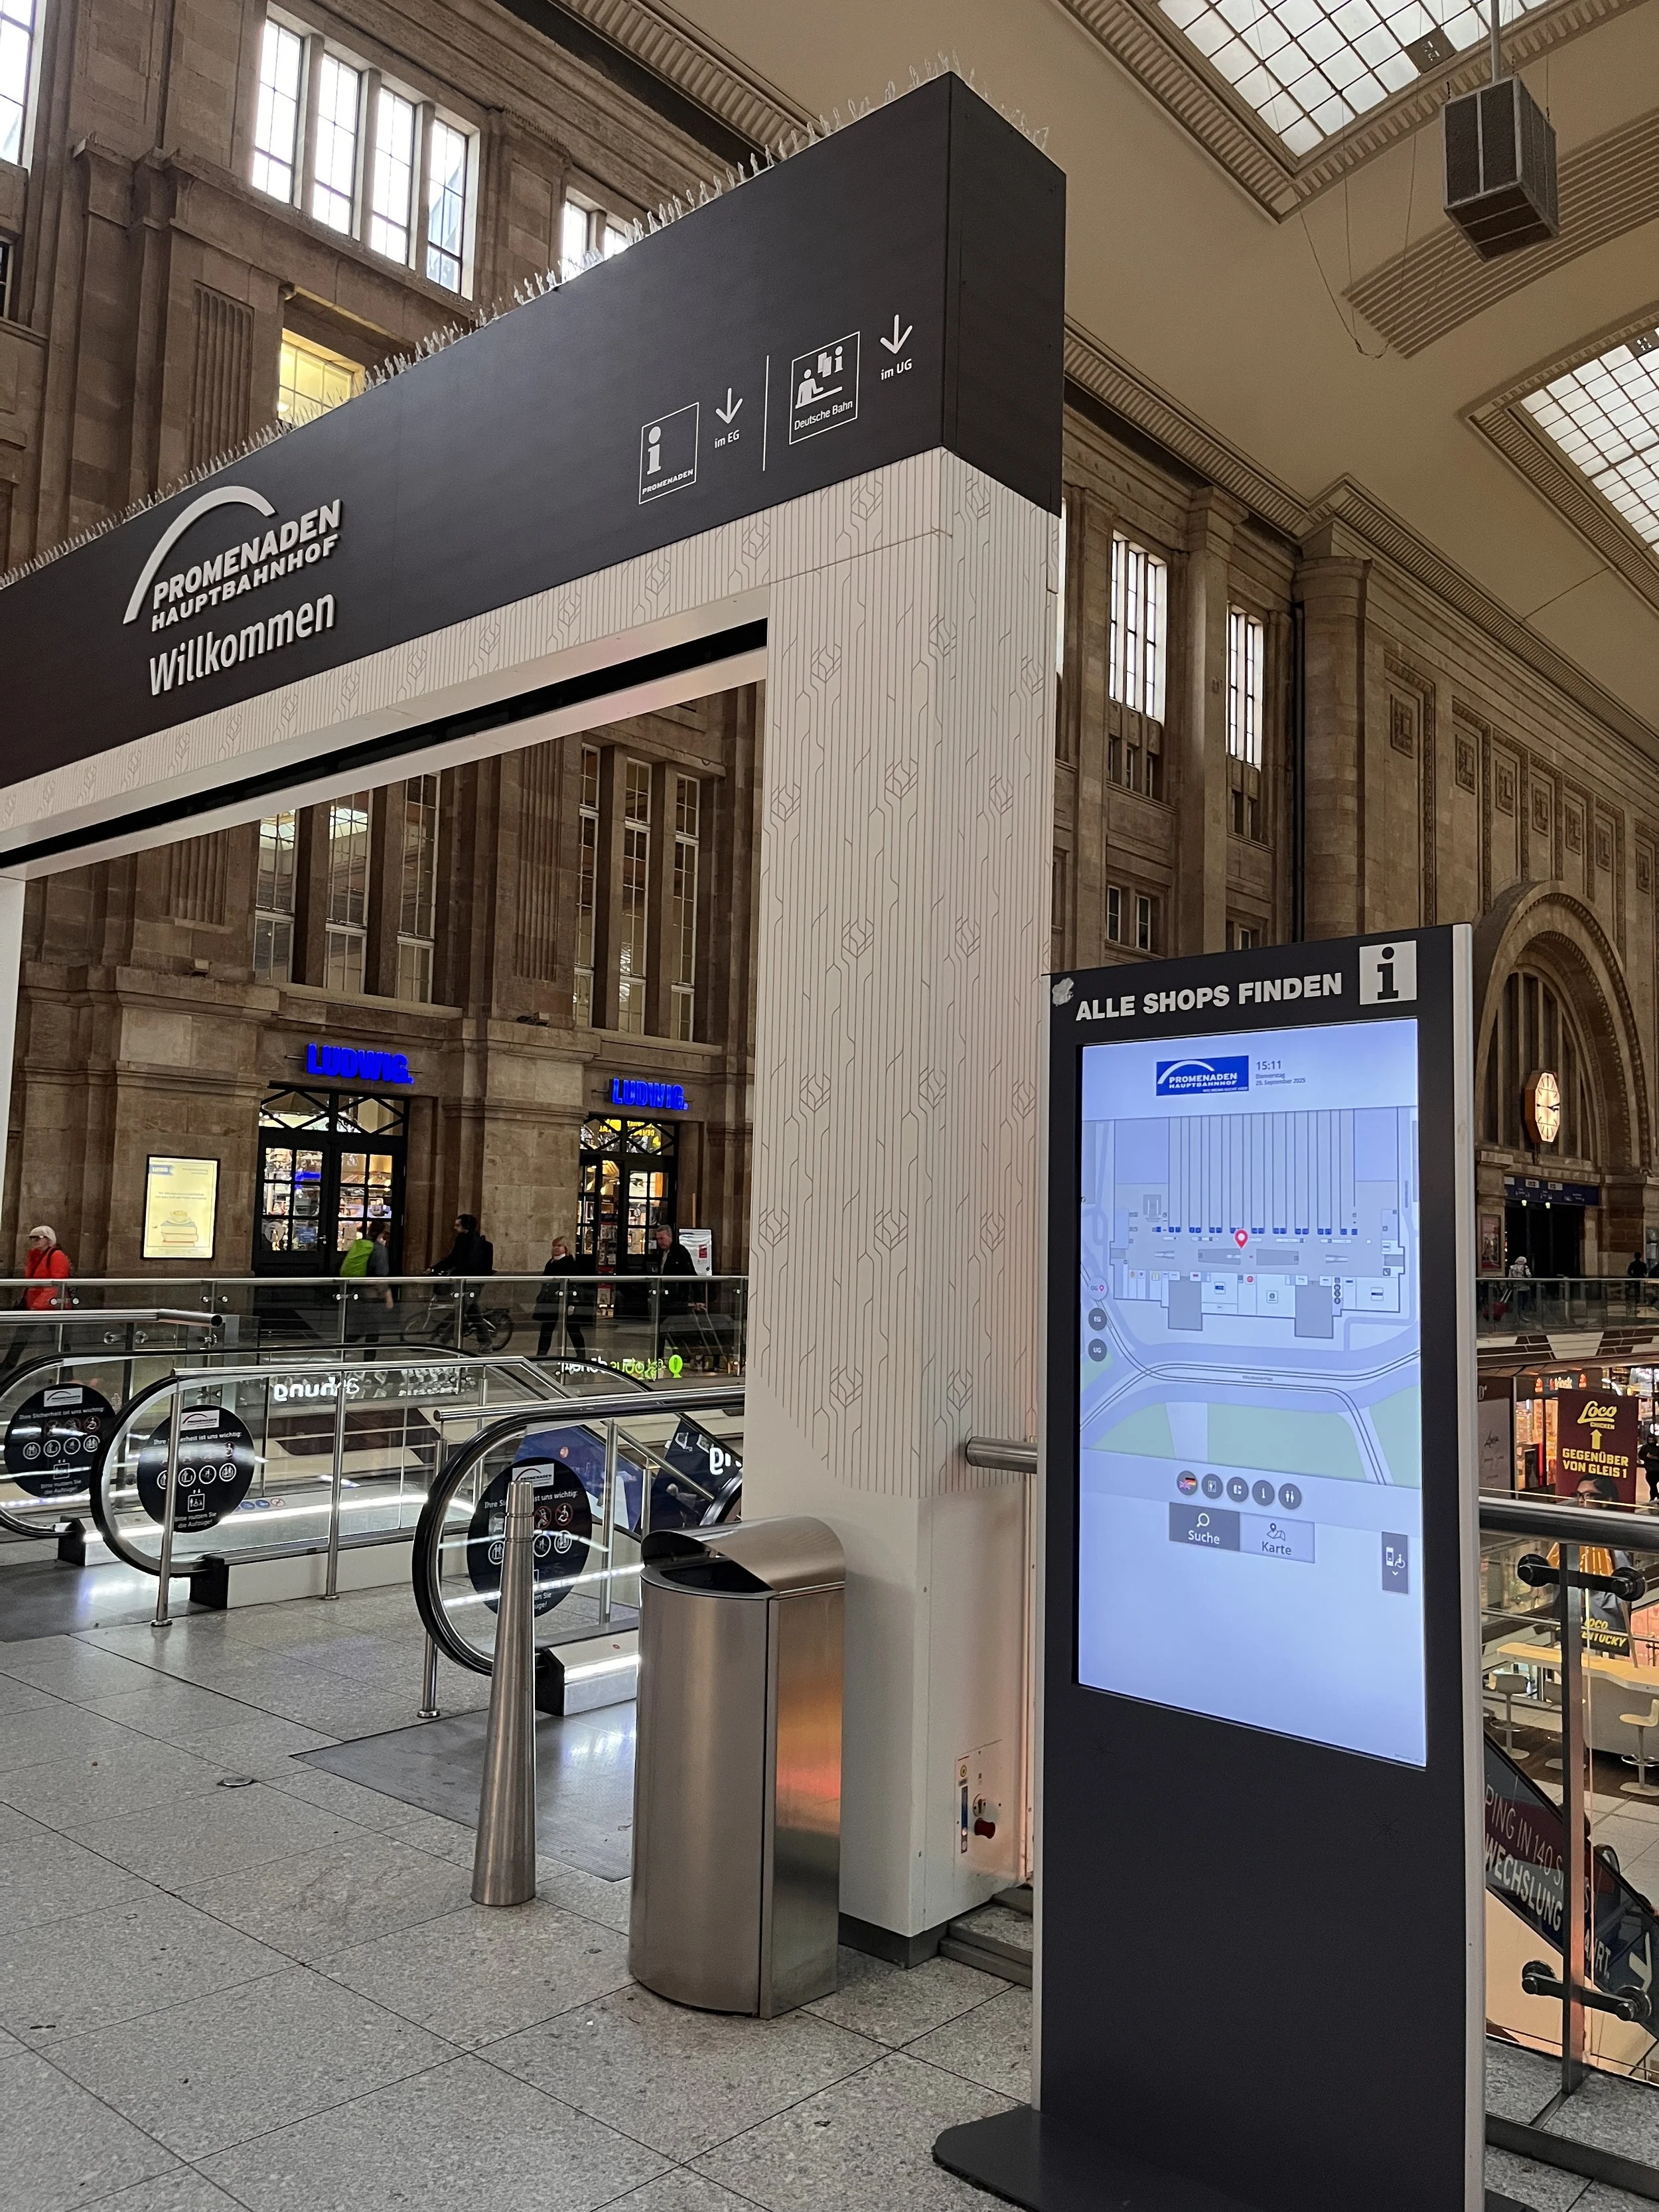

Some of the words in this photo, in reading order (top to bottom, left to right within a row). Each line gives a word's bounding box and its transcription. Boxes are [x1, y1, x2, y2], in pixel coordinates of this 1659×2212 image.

[881, 368, 894, 381] im
[897, 358, 912, 374] UG
[794, 409, 831, 430] Deutsche
[832, 400, 853, 417] Bahn
[715, 437, 725, 449] im
[728, 429, 740, 443] EG
[642, 469, 694, 495] PROMENADEN
[153, 499, 342, 609] PROMENADEN
[151, 534, 340, 632] HAUPTBAHNHOF
[149, 594, 336, 696] Willkommen
[1075, 995, 1135, 1021] ALLE
[1143, 985, 1230, 1014] SHOPS
[1238, 972, 1342, 1005] FINDEN
[1256, 1061, 1281, 1070] 15:11
[1169, 1072, 1238, 1084] PROMENADEN
[1577, 1400, 1617, 1424] Loco
[1562, 1448, 1629, 1467] GEGENÜBER
[1563, 1459, 1586, 1472] VON
[1588, 1463, 1621, 1477] GLEIS
[1623, 1469, 1627, 1478] 1
[1187, 1529, 1220, 1545] Suche
[1262, 1541, 1292, 1556] Karte
[1581, 1631, 1627, 1647] ENTUCKY
[1484, 1784, 1516, 1840] PING
[1517, 1818, 1532, 1856] IN
[1533, 1834, 1553, 1876] 140
[1485, 1833, 1563, 1931] WECHSLUNG
